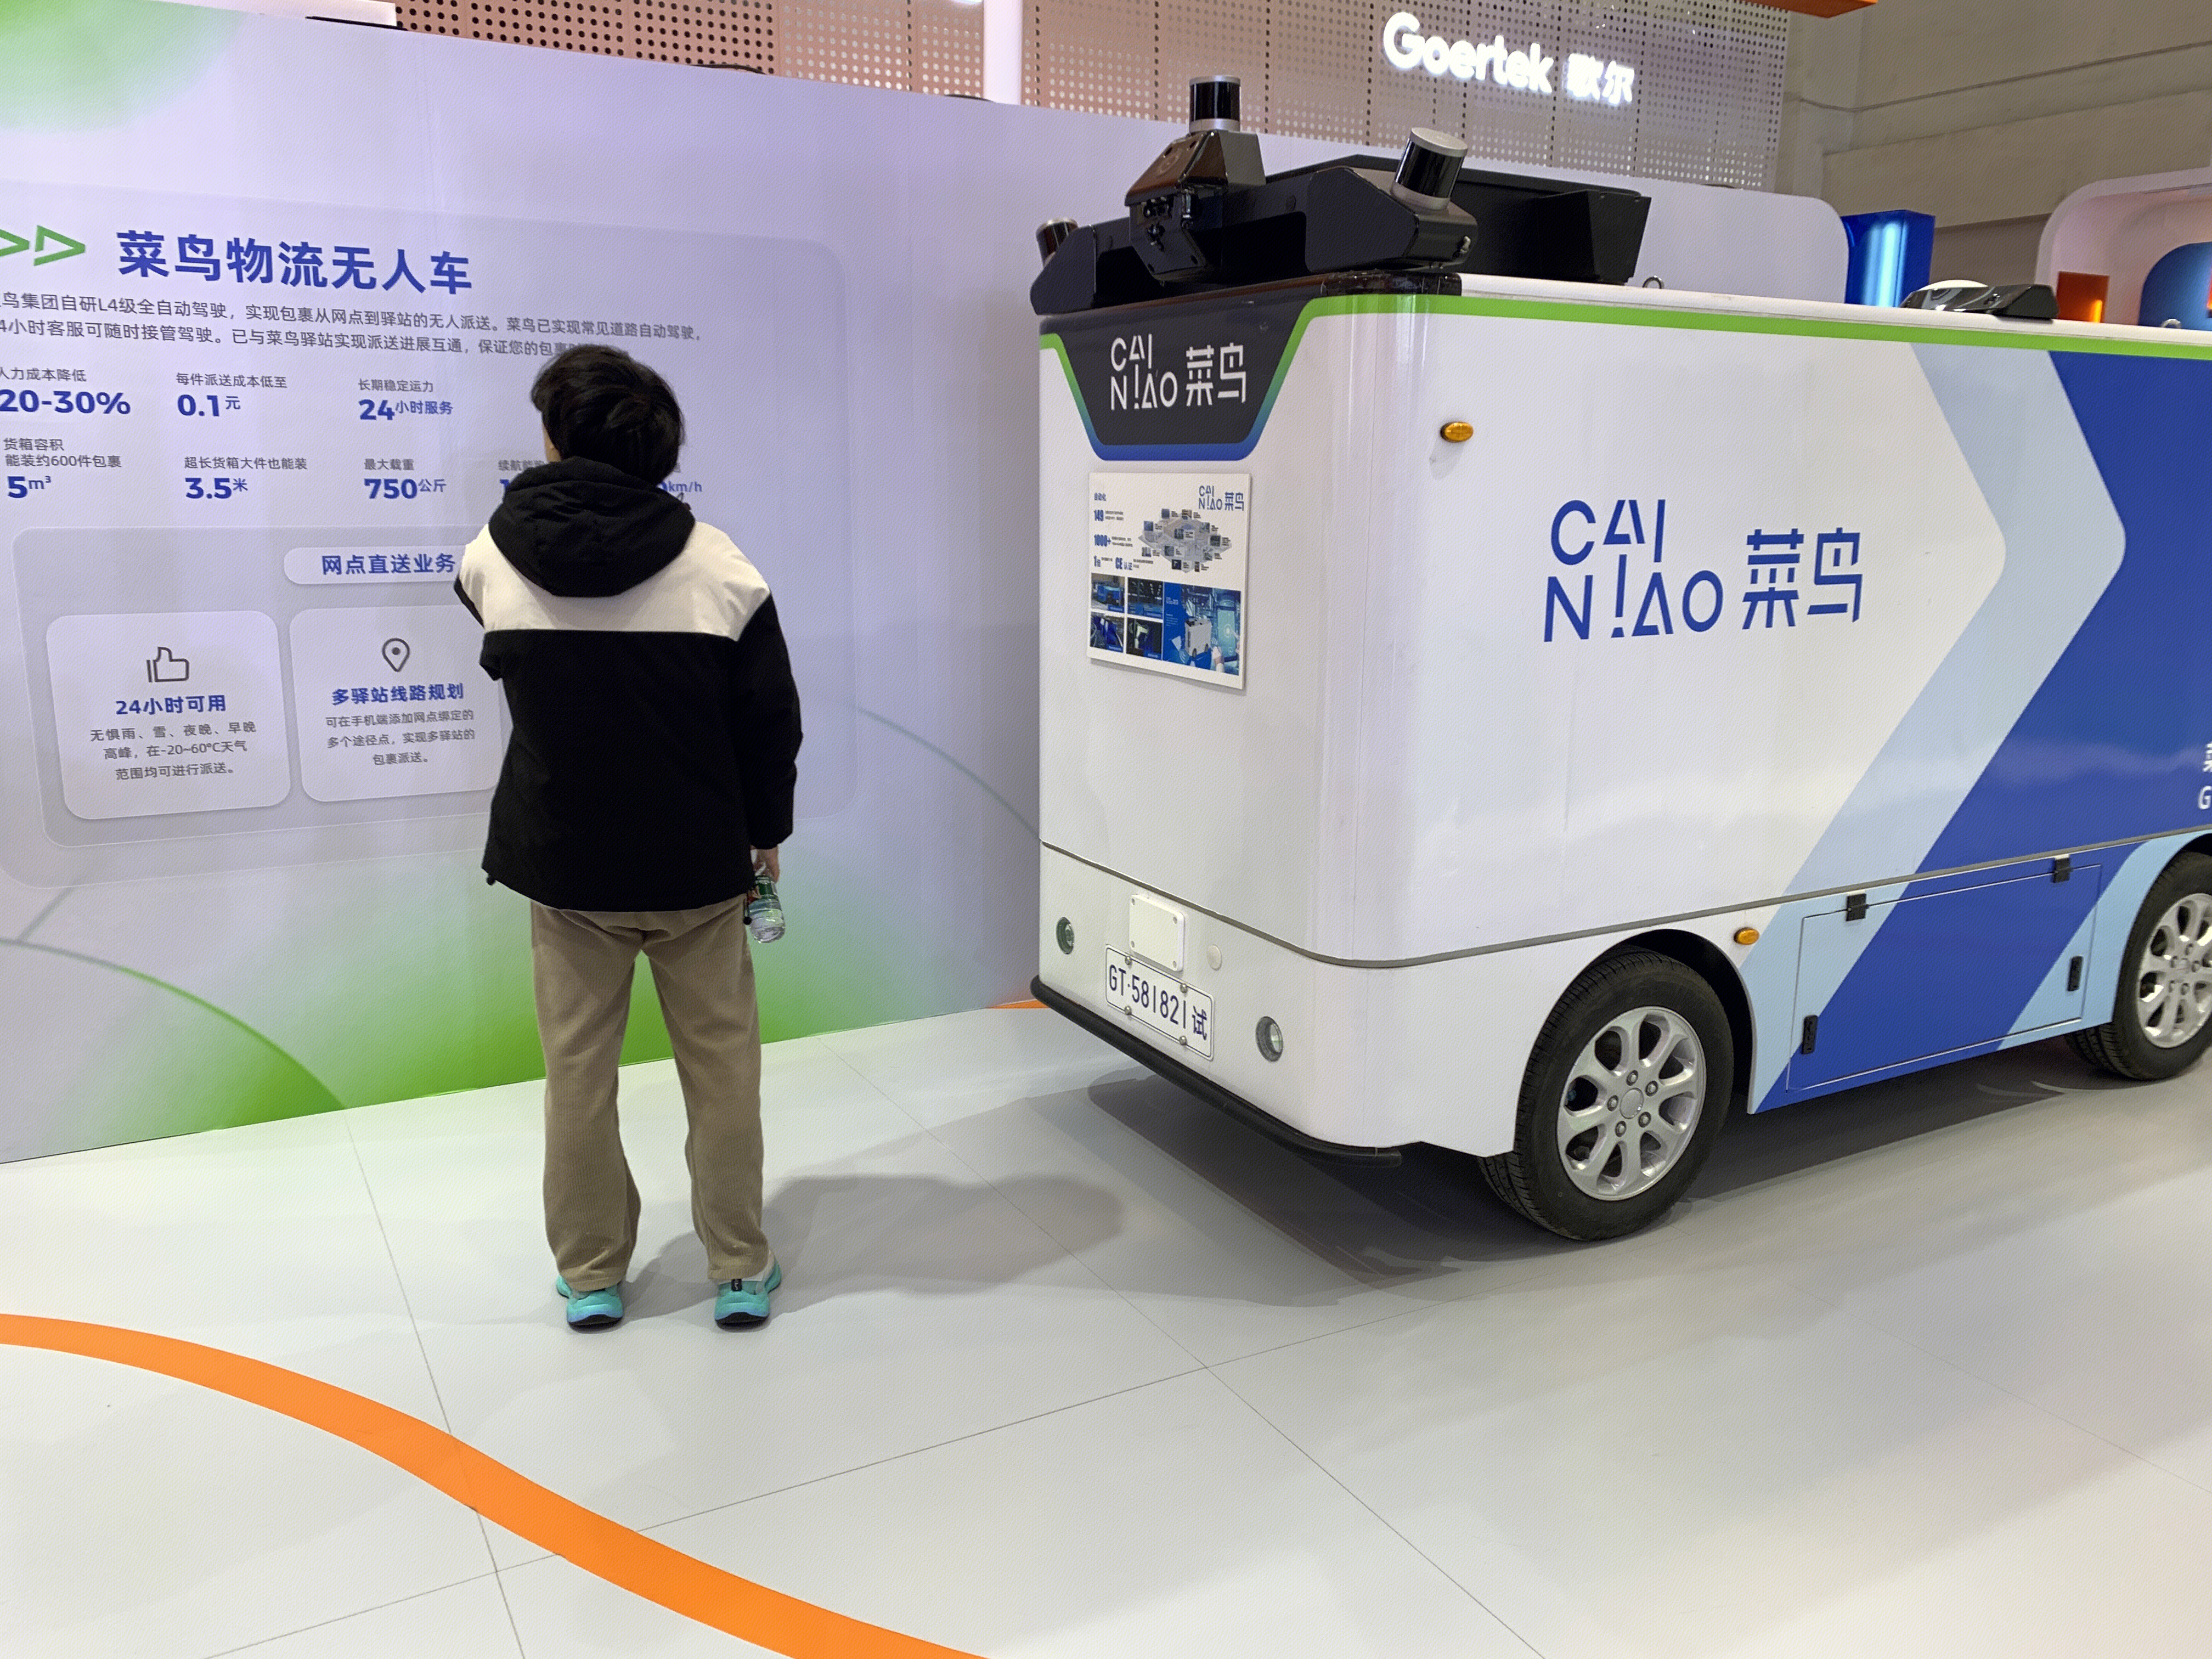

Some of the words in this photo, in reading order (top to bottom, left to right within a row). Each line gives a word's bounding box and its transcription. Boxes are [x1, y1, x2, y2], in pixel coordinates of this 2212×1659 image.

[1383, 12, 1554, 93] Goertek
[116, 230, 471, 294] 菜鸟物流无人车
[1111, 334, 1153, 371] CAI
[176, 373, 287, 388] 每件派送成本低至
[1186, 342, 1246, 407] 菜鸟
[358, 379, 433, 392] 长期稳定运力
[0, 389, 131, 414] 20-30%
[4, 438, 64, 451] 货箱容积
[5, 455, 122, 467] 能装约600件包裹
[184, 456, 308, 470] 超长货箱大件也能装
[364, 459, 414, 470] 最大载重
[1199, 486, 1215, 497] CAI
[1224, 492, 1245, 511] 菜鸟
[1551, 499, 1666, 566] CAI
[321, 553, 455, 575] 网点直送业务
[1742, 527, 1863, 630] 菜鸟
[332, 682, 464, 706] 多驿站线路规划
[116, 695, 226, 715] 24小时可用
[325, 709, 474, 728] 可在手机端添加网点绑定的
[115, 762, 233, 780] 范围均可进行派送。
